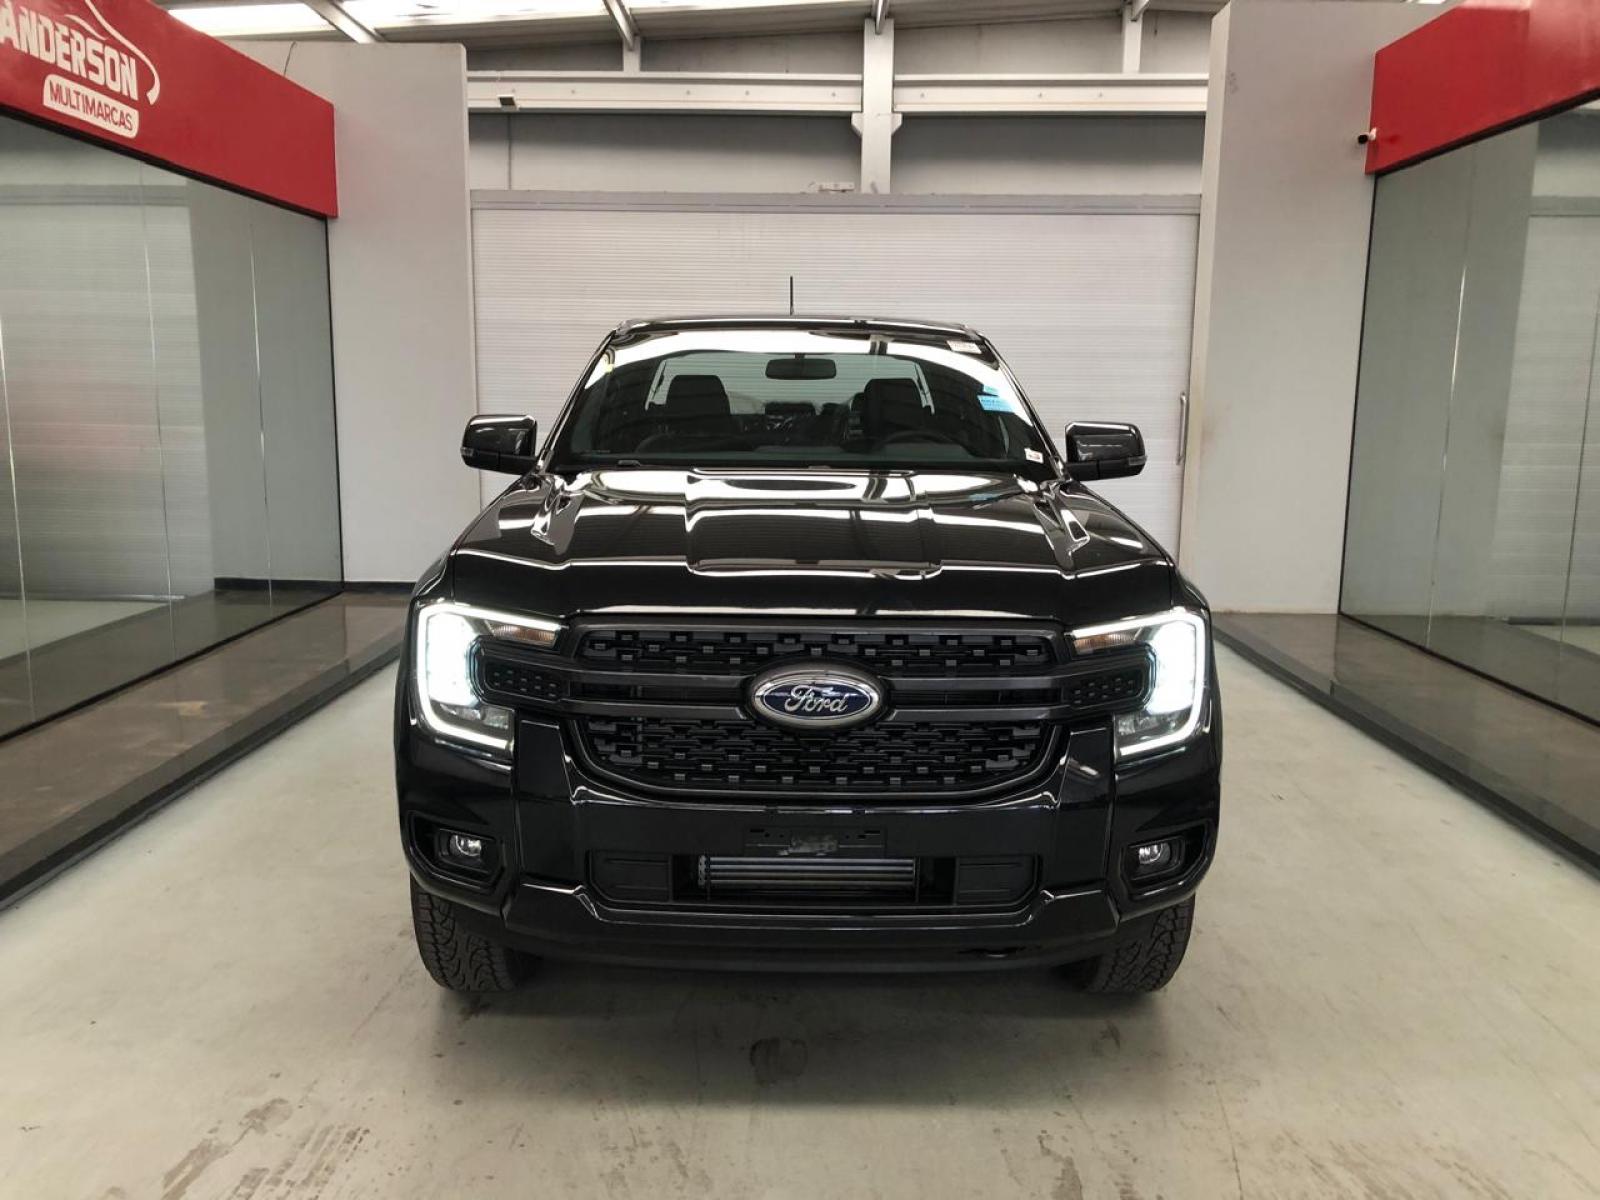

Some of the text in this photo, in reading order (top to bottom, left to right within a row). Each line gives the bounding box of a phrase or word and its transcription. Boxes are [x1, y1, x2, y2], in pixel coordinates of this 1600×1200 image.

[0, 0, 138, 101] ANDERSON
[49, 79, 133, 131] MULTIMARCAS
[784, 684, 849, 712] Ford
